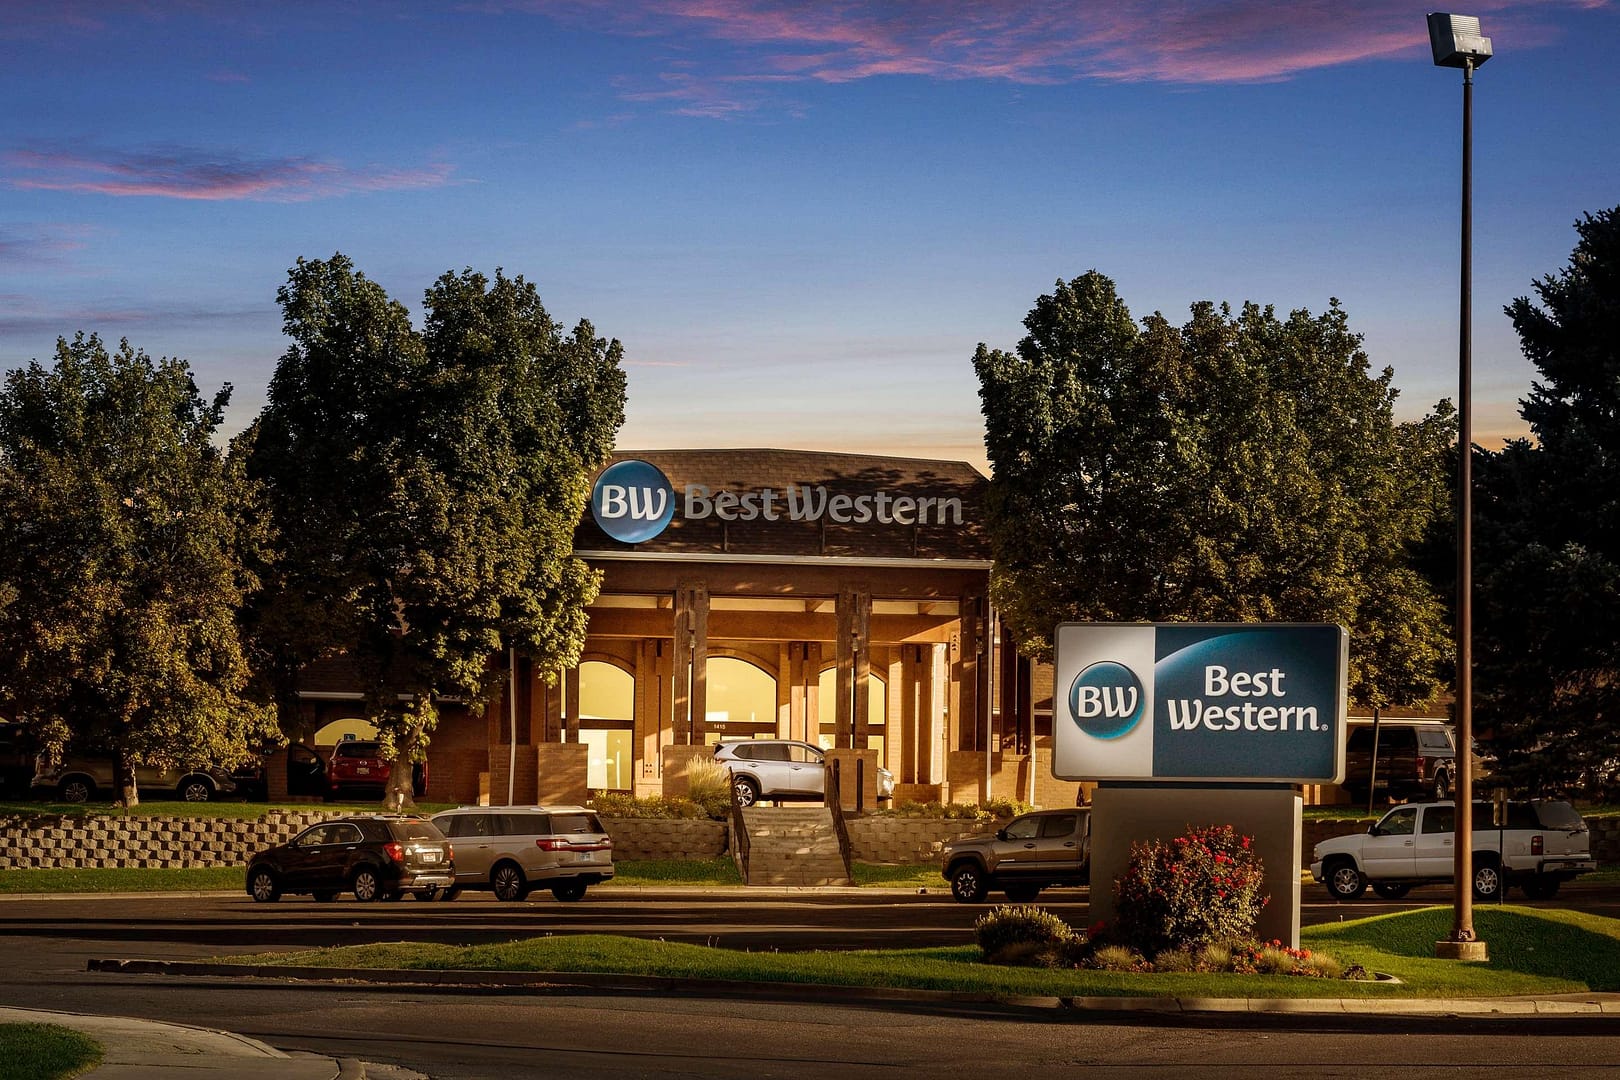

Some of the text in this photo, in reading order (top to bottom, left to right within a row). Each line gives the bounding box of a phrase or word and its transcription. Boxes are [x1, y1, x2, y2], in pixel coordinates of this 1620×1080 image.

[600, 483, 668, 521] BW
[684, 483, 964, 525] Best Western
[1204, 665, 1286, 697] Best
[1077, 685, 1138, 718] BW
